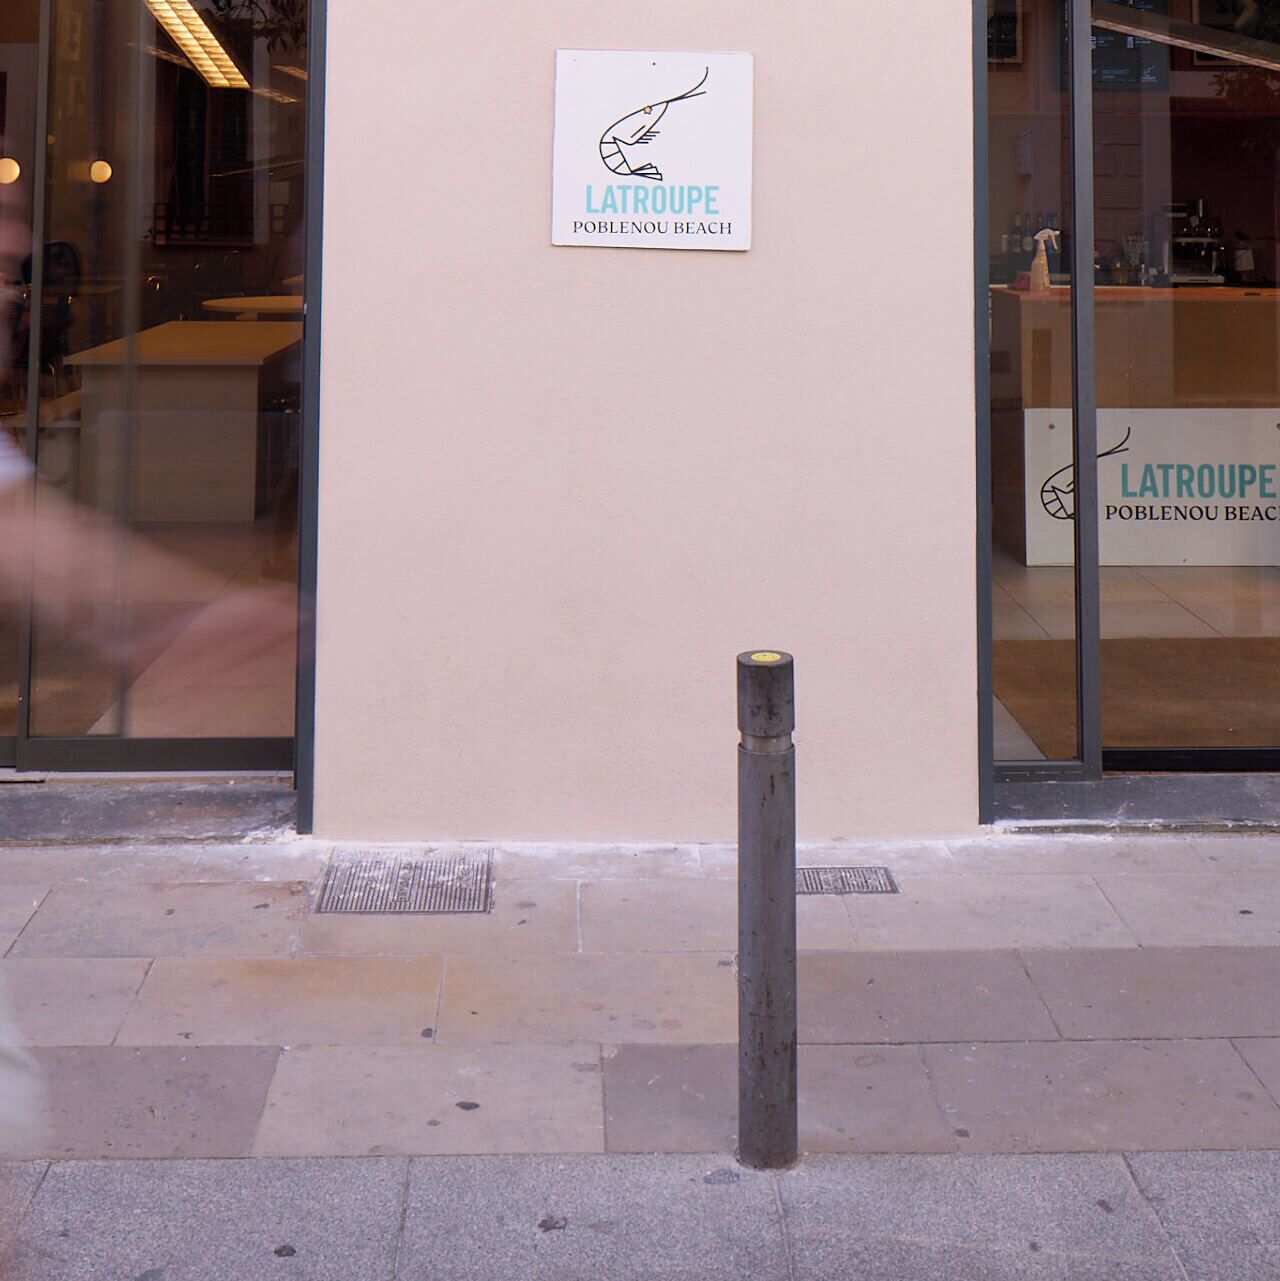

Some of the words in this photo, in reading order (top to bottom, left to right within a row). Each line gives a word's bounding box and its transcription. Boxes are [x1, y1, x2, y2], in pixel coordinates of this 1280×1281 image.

[586, 185, 720, 214] LATROUPE
[573, 221, 669, 234] POBLENOU
[674, 222, 732, 235] BEACH
[1121, 464, 1277, 498] LATROUPE
[1105, 505, 1218, 520] POBLENOU
